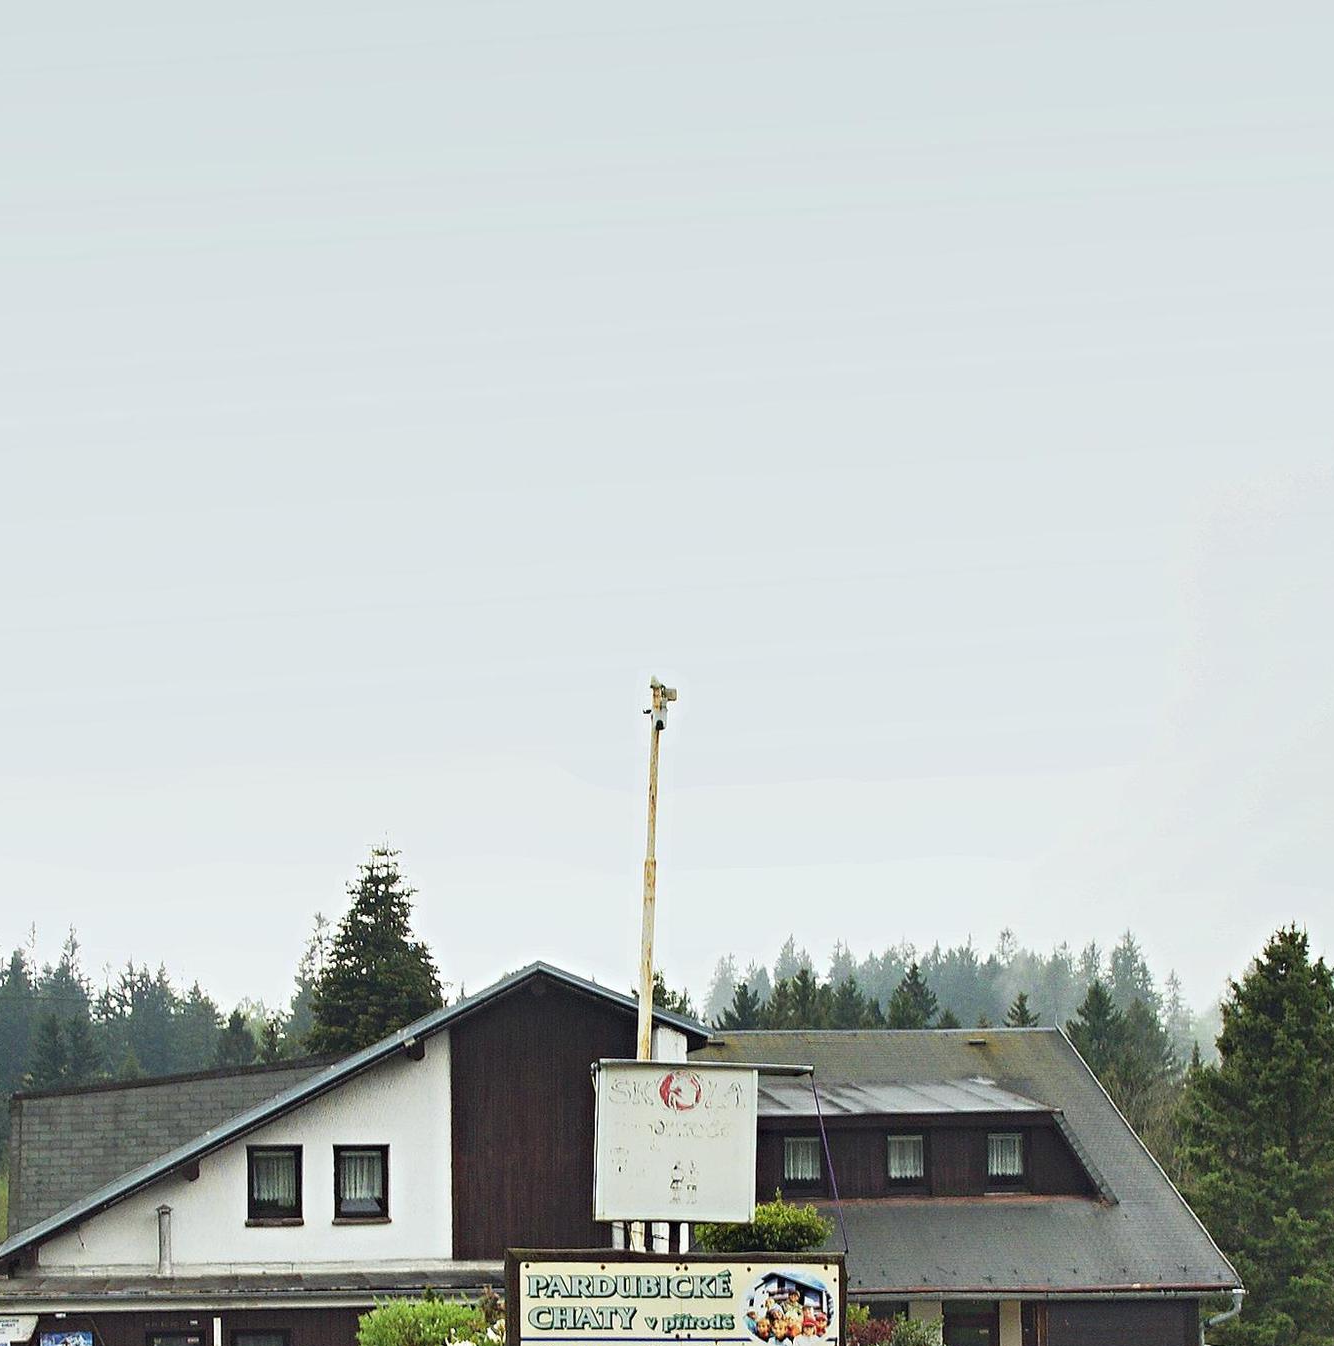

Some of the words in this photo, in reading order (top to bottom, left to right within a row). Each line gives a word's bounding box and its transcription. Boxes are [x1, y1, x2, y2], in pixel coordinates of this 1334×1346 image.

[526, 1269, 734, 1299] PARDUBICKÉ
[528, 1305, 637, 1331] CHATY
[644, 1315, 658, 1331] v
[661, 1313, 736, 1333] přírodě
